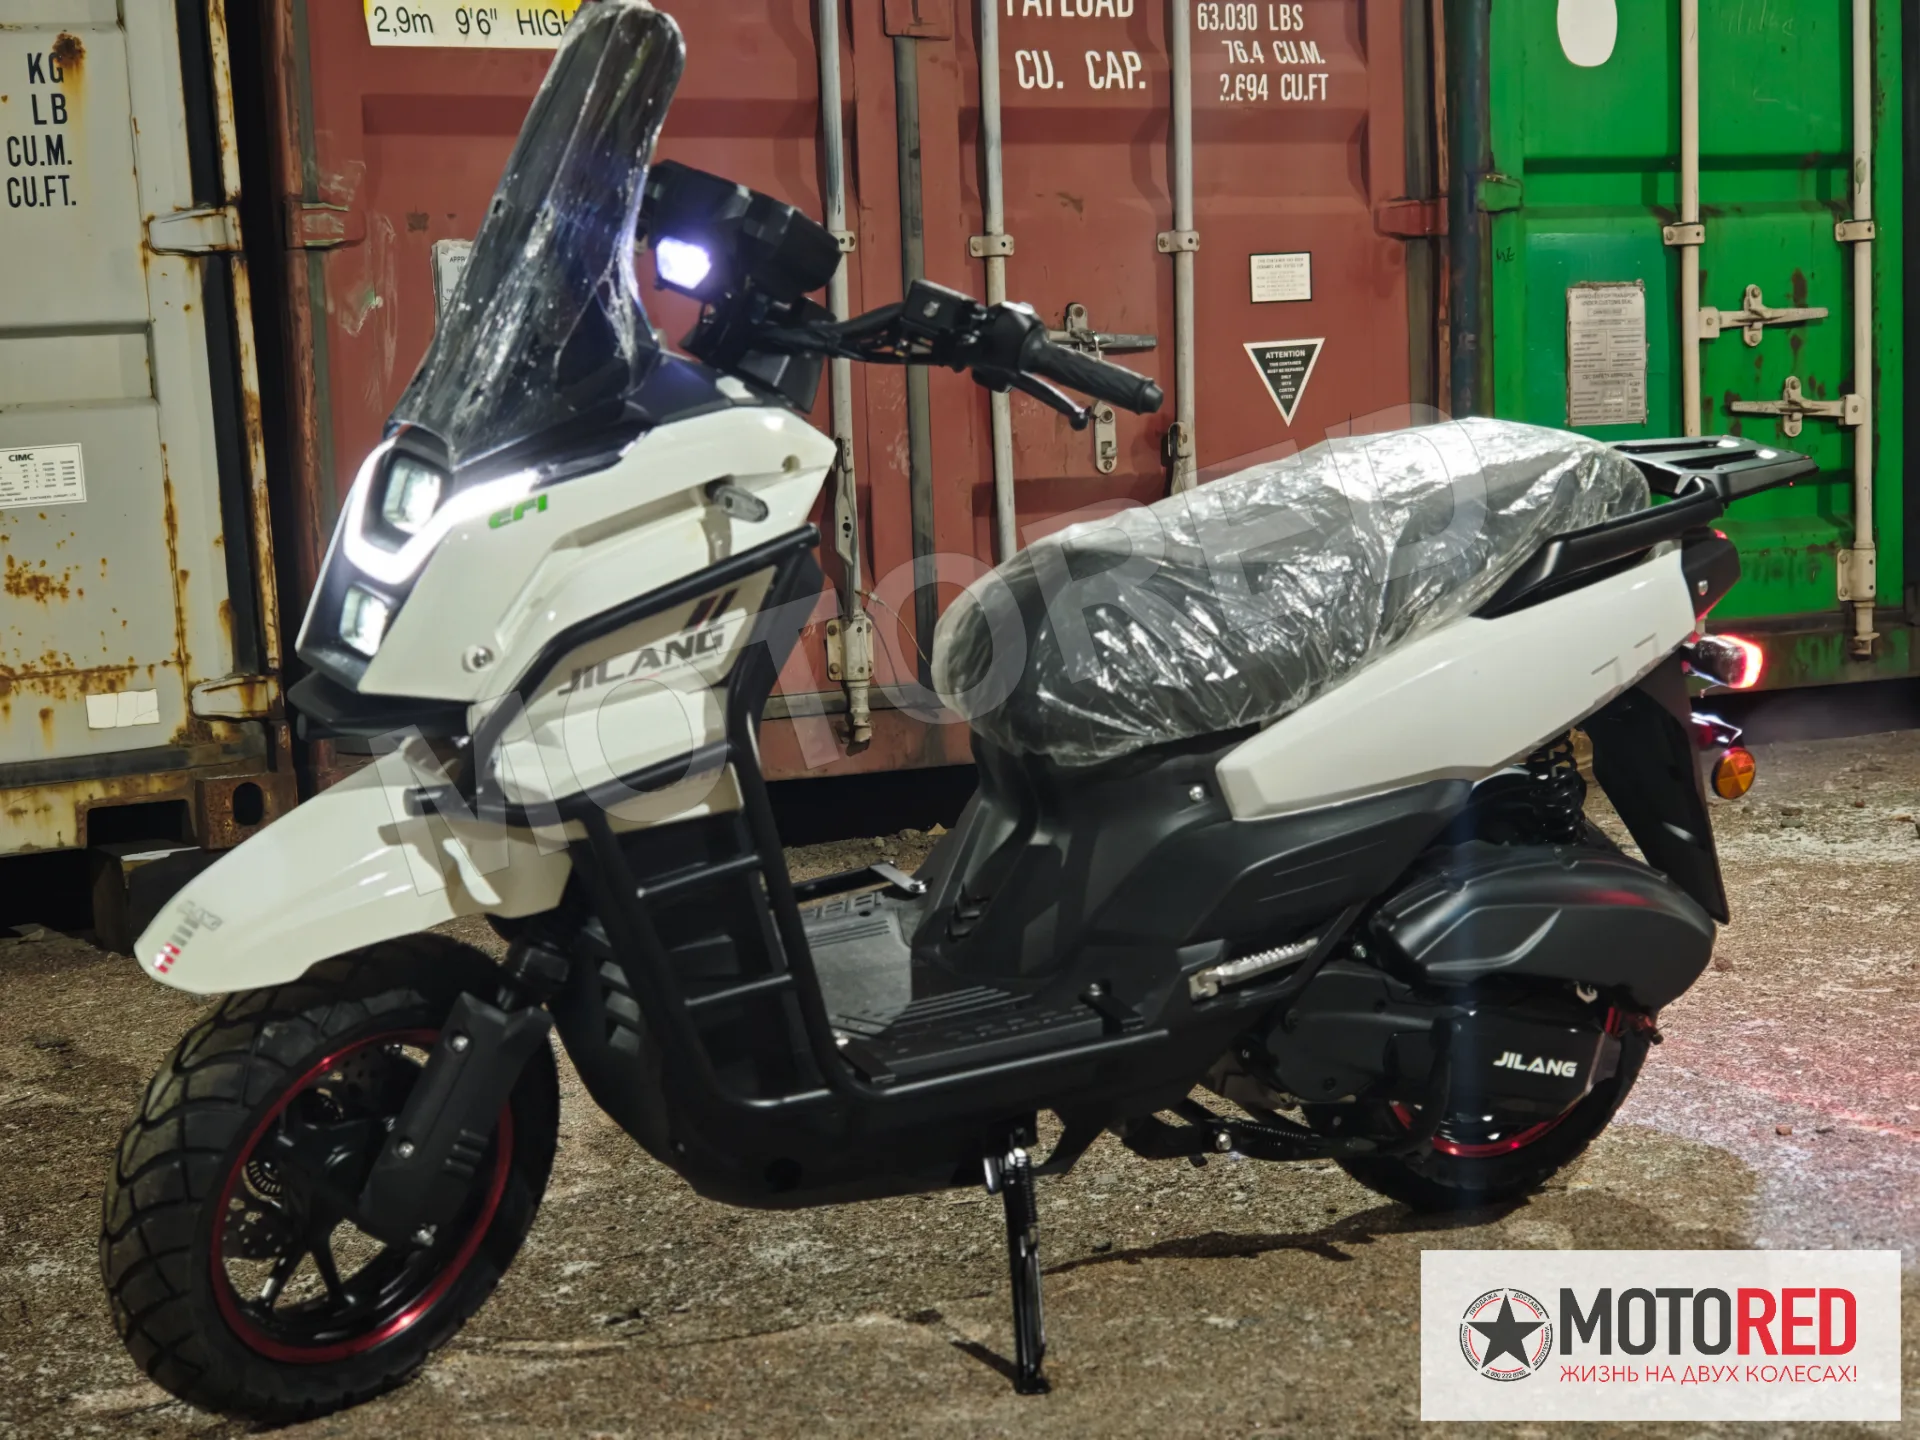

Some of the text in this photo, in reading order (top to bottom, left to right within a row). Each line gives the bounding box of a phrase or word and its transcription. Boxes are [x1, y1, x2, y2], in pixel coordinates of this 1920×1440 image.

[374, 6, 434, 37] 2,9m
[1268, 4, 1304, 31] LBS
[1221, 40, 1326, 64] 76.4 CU.M.
[27, 52, 65, 84] KG
[1015, 50, 1146, 89] CU. CAP.
[1280, 73, 1329, 101] CU.FT
[32, 93, 68, 125] LB
[6, 134, 73, 167] CU.M.
[6, 175, 77, 208] CU.FT.
[1265, 350, 1306, 359] ATTENTION
[8, 453, 34, 462] CIMC
[557, 625, 725, 696] JILANG
[1493, 1051, 1578, 1078] JILANG
